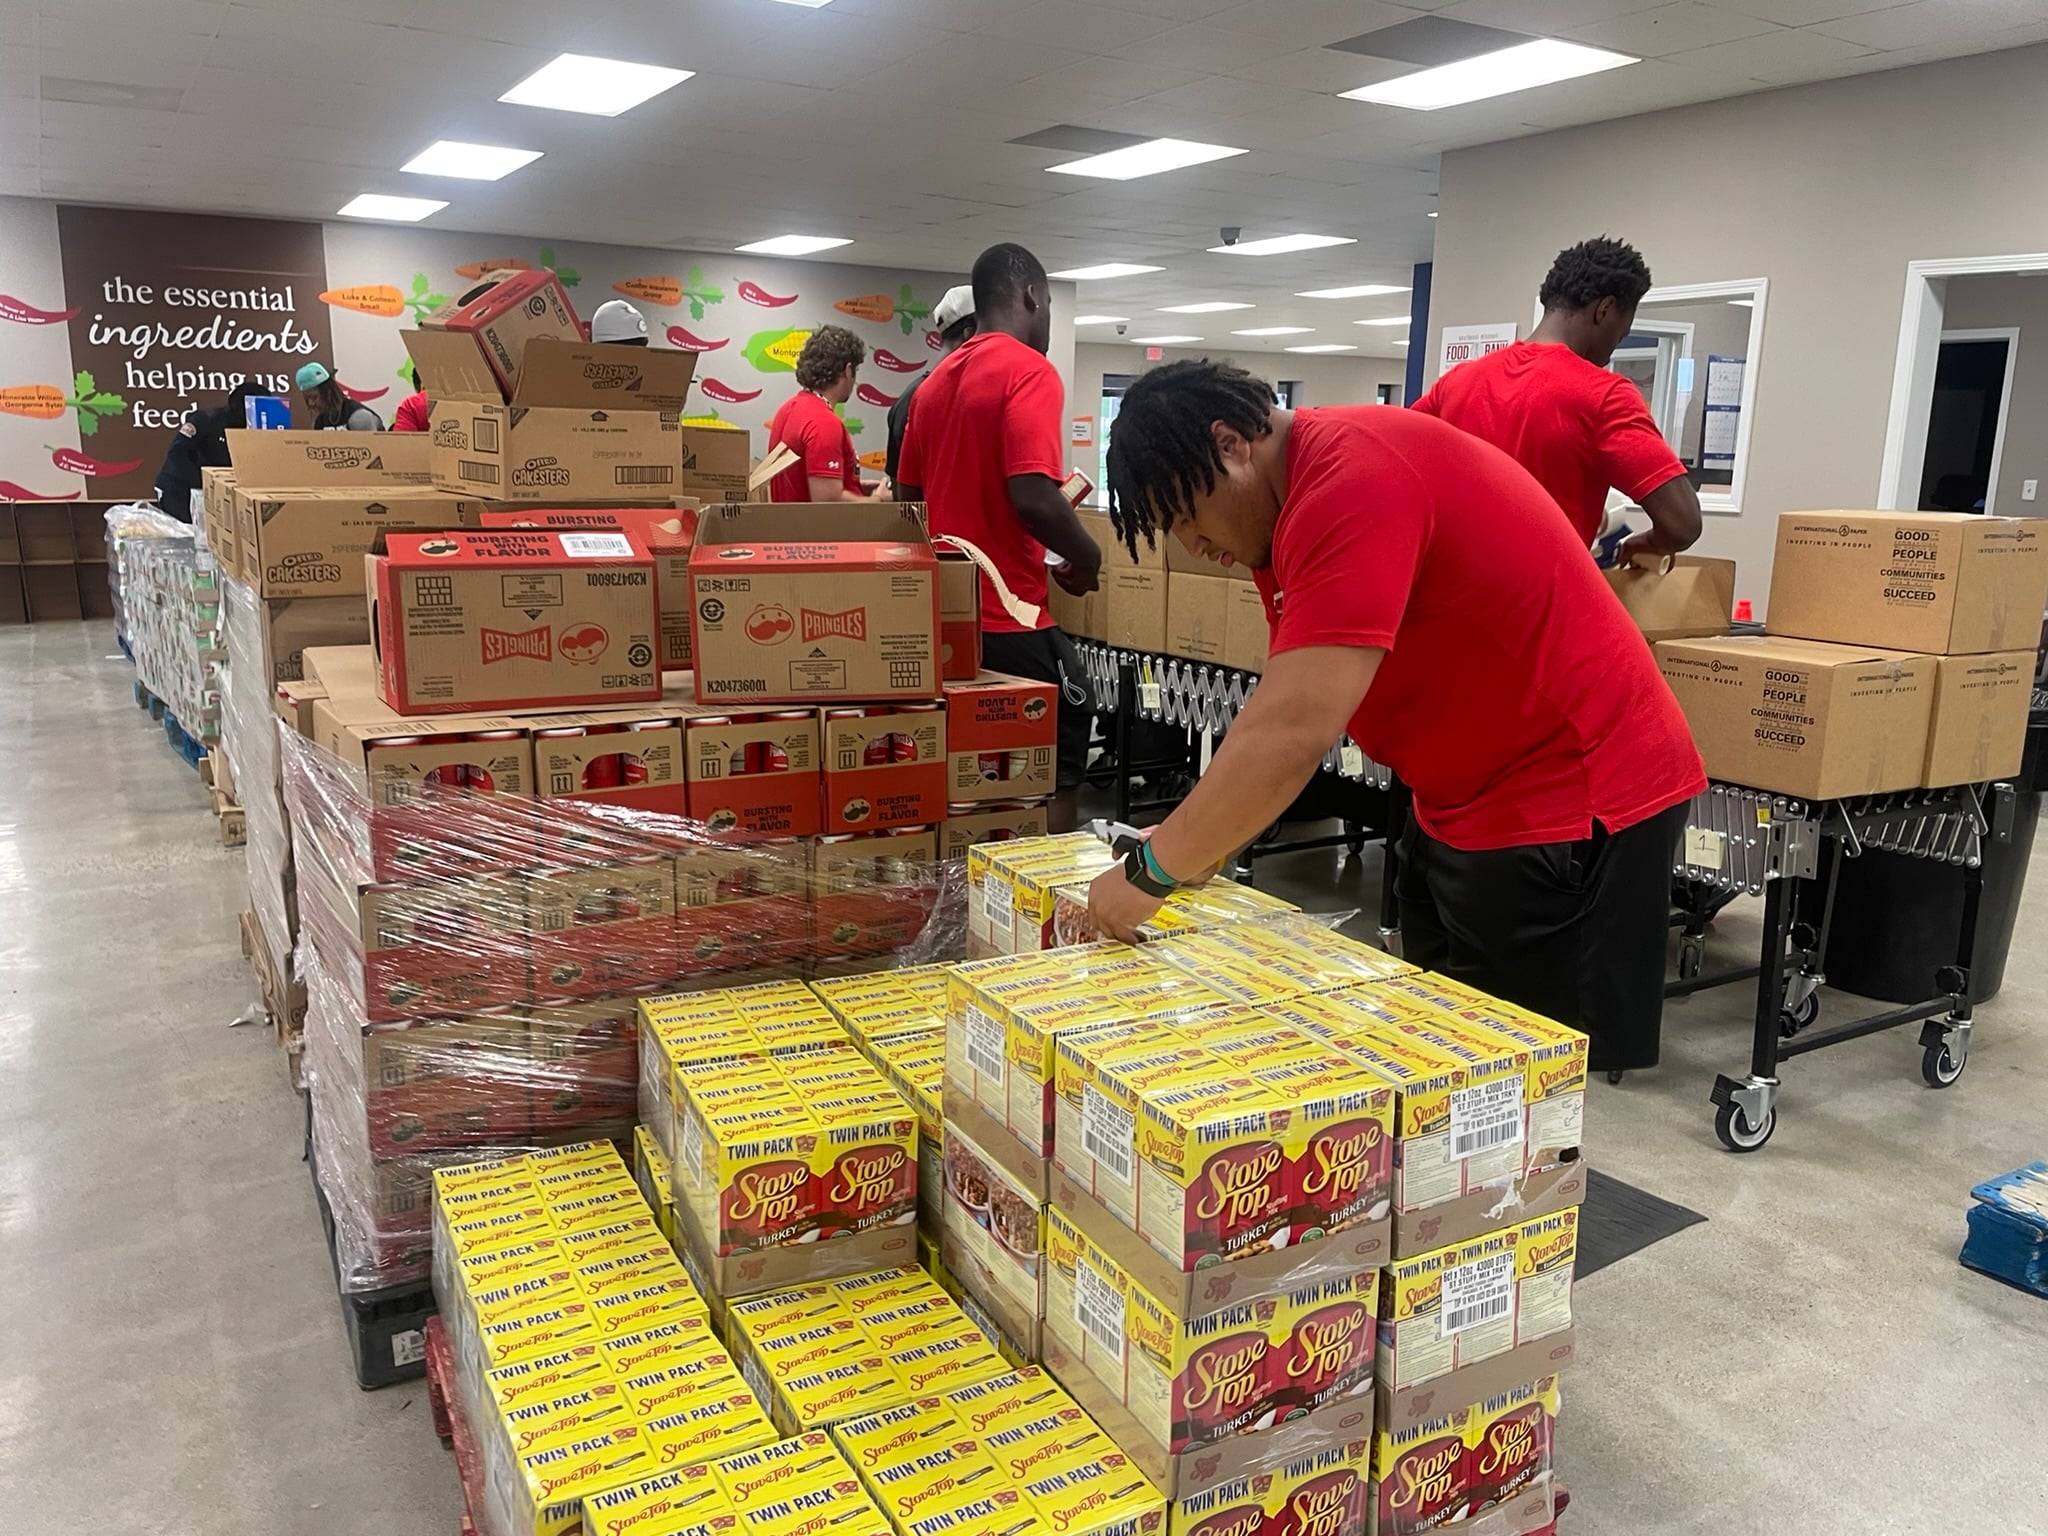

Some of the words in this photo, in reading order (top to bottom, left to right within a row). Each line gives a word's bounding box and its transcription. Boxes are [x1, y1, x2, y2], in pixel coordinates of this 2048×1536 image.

[103, 276, 153, 306] the
[164, 285, 295, 312] essential
[89, 314, 318, 359] ingredients
[1447, 345, 1469, 360] FOOD
[125, 361, 246, 397] helping
[255, 374, 290, 392] us
[434, 430, 468, 449] CAKESTERS
[307, 447, 371, 461] CAKESTERS
[512, 469, 570, 486] CAKESTERS
[547, 516, 616, 524] BURSTING
[1895, 531, 1929, 541] GOOD
[475, 549, 552, 557] FLAVOR
[1893, 549, 1937, 560] PEOPLE
[267, 565, 341, 583] CAKESTERS
[587, 573, 646, 586] K204736001
[1880, 569, 1945, 580] COMMUNITIES
[1884, 588, 1936, 600] SUCCEED
[805, 611, 862, 638] PRINGLES
[485, 628, 548, 660] PRINGLES
[1667, 658, 1709, 667] INTERNATIONAL
[707, 679, 767, 693] K204736001
[1714, 678, 1743, 686] PEOPLE
[1766, 671, 1799, 683] GOOD
[977, 698, 1017, 708] FLAVOR
[1763, 689, 1806, 704] PEOPLE
[975, 712, 1017, 721] BURSTING
[1751, 708, 1814, 725] COMMUNITIES
[1754, 729, 1805, 745] SUCCEED
[744, 805, 792, 816] BURSTING
[876, 794, 921, 805] BURSTING
[746, 820, 791, 832] FLAVOR
[758, 814, 778, 822] WITH
[879, 809, 919, 821] FLAVOR
[1532, 1050, 1553, 1062] TWIN
[1555, 1043, 1573, 1056] PACK
[1405, 1083, 1425, 1098] TWIN
[1427, 1076, 1449, 1092] PACK
[1302, 1098, 1335, 1121] TWIN
[1339, 1092, 1367, 1114] PACK
[1457, 1103, 1465, 1111] ST
[1467, 1097, 1485, 1109] STUFF
[1501, 1090, 1516, 1099] TRKY
[829, 1126, 858, 1144] TWIN
[863, 1120, 891, 1139] PACK
[1196, 1121, 1230, 1144] TWIN
[1234, 1113, 1266, 1135] PACK
[727, 1142, 758, 1161] TWIN
[760, 1137, 793, 1157] PACK
[1303, 1125, 1380, 1194] Stove
[438, 1166, 469, 1178] TWIN
[474, 1160, 503, 1172] PACK
[831, 1151, 905, 1203] Stove
[1330, 1159, 1369, 1202] Top
[730, 1167, 809, 1220] Stove
[858, 1176, 894, 1210] Top
[1197, 1148, 1282, 1220] Stove
[760, 1193, 797, 1228] Top
[1227, 1185, 1271, 1228] Top
[1329, 1199, 1367, 1225] TURKEY
[857, 1210, 893, 1229] TURKEY
[1522, 1222, 1540, 1239] TWIN
[1542, 1216, 1562, 1232] PACK
[757, 1227, 798, 1247] TURKEY
[1226, 1222, 1268, 1252] TURKEY
[462, 1255, 497, 1268] TWIN
[501, 1244, 534, 1258] PACK
[1462, 1245, 1482, 1260] TWIN
[1484, 1238, 1504, 1254] PACK
[1449, 1280, 1456, 1289] ST
[1458, 1274, 1477, 1284] STUFF
[1479, 1271, 1490, 1279] MIX
[1492, 1266, 1506, 1275] TRKY
[1288, 1285, 1318, 1308] TWIN
[1323, 1276, 1352, 1300] PACK
[1183, 1313, 1218, 1338] TWIN
[1221, 1305, 1252, 1328] PACK
[1287, 1309, 1363, 1377] Stove
[491, 1364, 530, 1382] TWIN
[534, 1352, 572, 1370] PACK
[1183, 1338, 1267, 1409] Stove
[1314, 1344, 1353, 1385] Top
[1214, 1373, 1256, 1416] Top
[1313, 1377, 1351, 1404] TURKEY
[1481, 1391, 1508, 1414] TWIN
[1510, 1381, 1535, 1405] PACK
[1212, 1411, 1254, 1438] TURKEY
[1026, 1477, 1066, 1498] TWIN
[1068, 1462, 1107, 1483] PACK
[591, 1487, 637, 1511] TWIN
[642, 1474, 683, 1496] PACK
